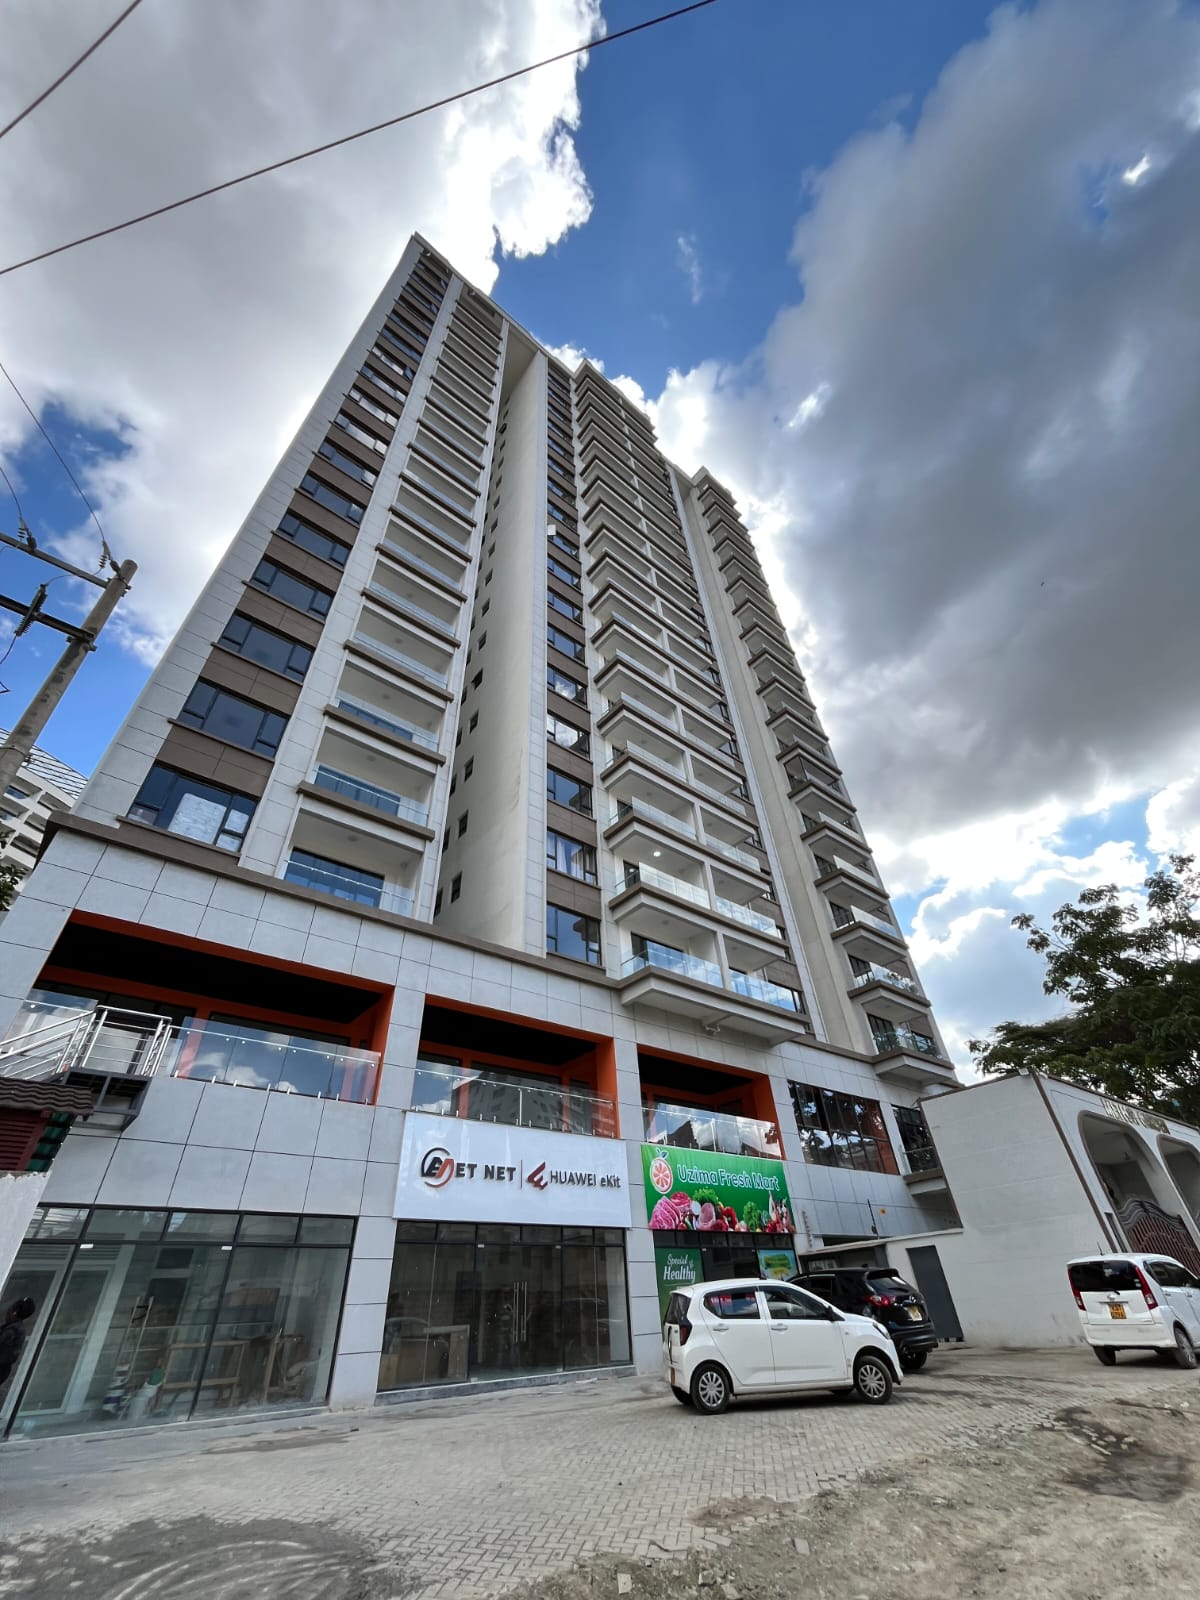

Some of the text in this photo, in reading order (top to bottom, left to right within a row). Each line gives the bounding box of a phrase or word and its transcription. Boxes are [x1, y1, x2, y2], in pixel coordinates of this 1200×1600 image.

[484, 1164, 516, 1182] NET
[549, 1170, 621, 1188] HUAWEI eKit
[677, 1164, 780, 1191] Uzima Fresh Mart
[667, 1253, 689, 1267] Special
[664, 1265, 696, 1284] Healthy
